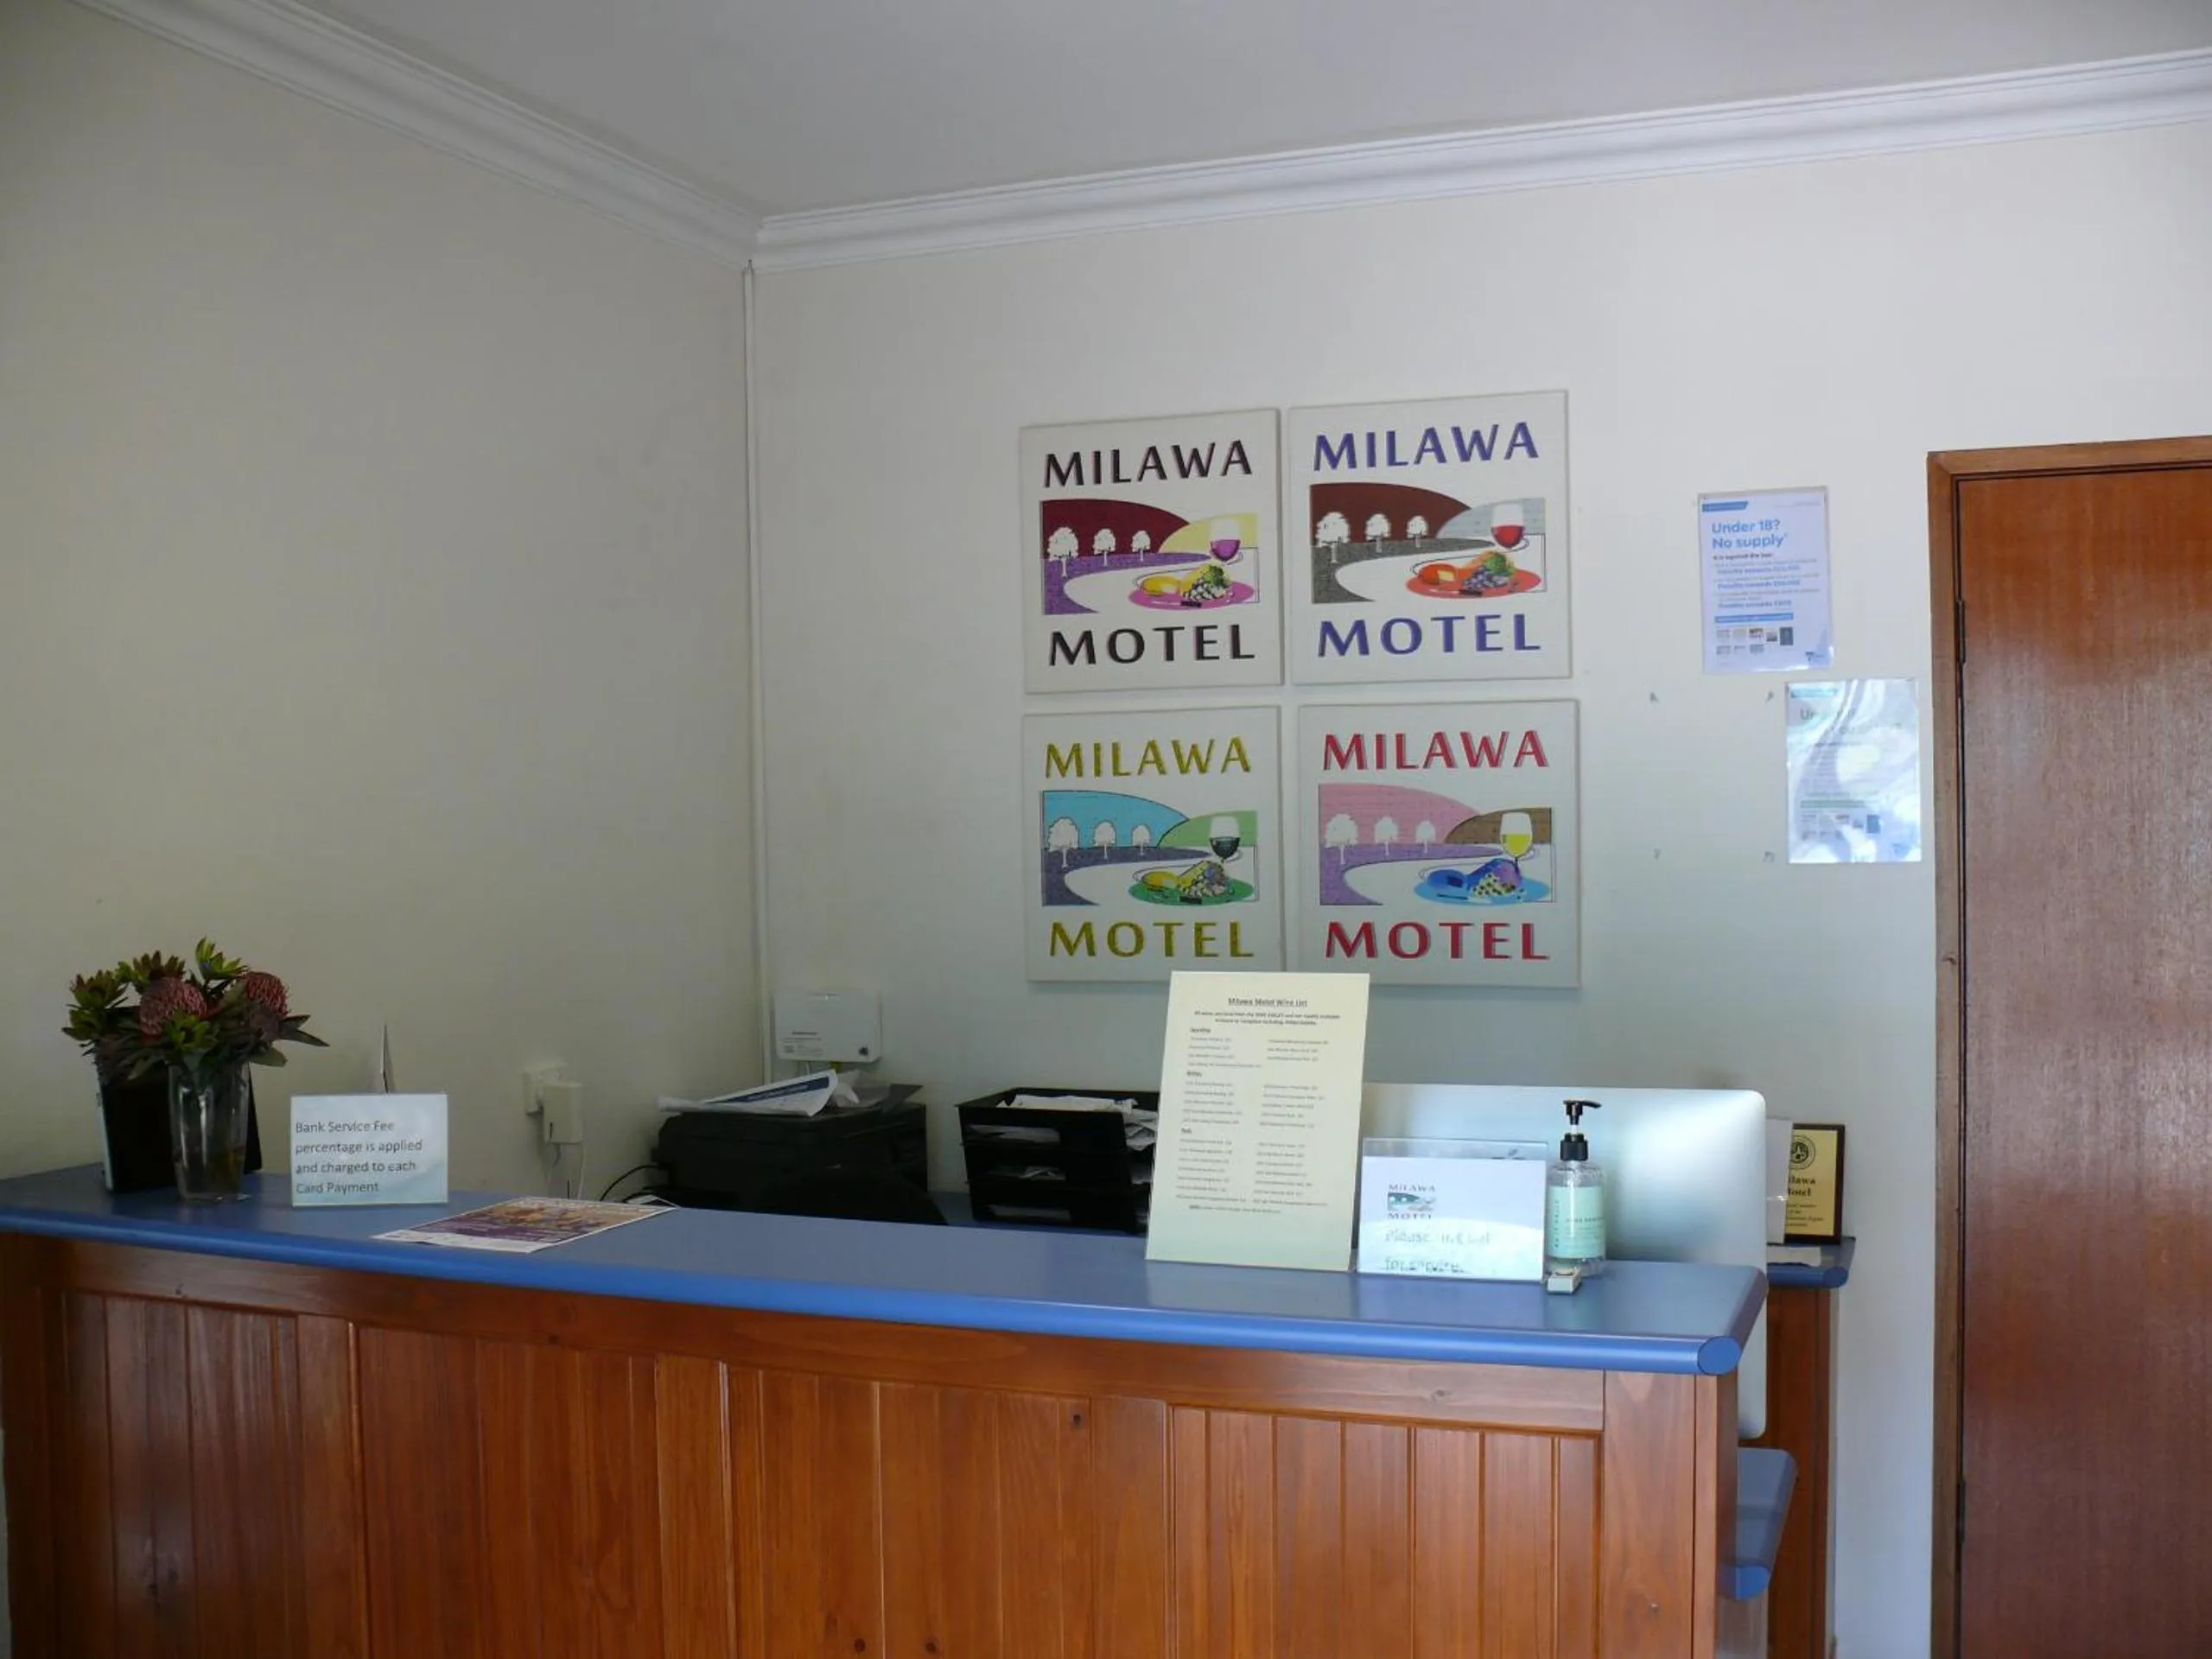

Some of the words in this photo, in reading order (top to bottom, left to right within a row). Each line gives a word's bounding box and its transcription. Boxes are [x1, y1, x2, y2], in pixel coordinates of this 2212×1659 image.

[1044, 439, 1253, 488] MILAWA
[1314, 422, 1539, 472] MILAWA
[1712, 522, 1756, 534] Under
[1759, 518, 1781, 531] 18?
[1712, 537, 1732, 550] No
[1048, 624, 1255, 667] MOTEL
[1318, 614, 1541, 658] MOTEL
[1045, 736, 1252, 779] MILAWA
[1323, 729, 1549, 772] MILAWA
[1049, 921, 1254, 958] MOTEL
[1325, 921, 1550, 960] MOTEL
[296, 1122, 325, 1134] Bank
[328, 1122, 372, 1133] Service
[373, 1121, 396, 1132] Fee
[296, 1141, 362, 1155] percentage
[366, 1141, 375, 1151] is
[378, 1139, 423, 1154] applied
[296, 1163, 318, 1174] and
[321, 1162, 369, 1175] charged
[372, 1162, 385, 1173] to
[388, 1160, 416, 1172] each
[296, 1183, 323, 1194] Card
[327, 1182, 378, 1196] Payment
[1389, 1184, 1436, 1192] MILAWA
